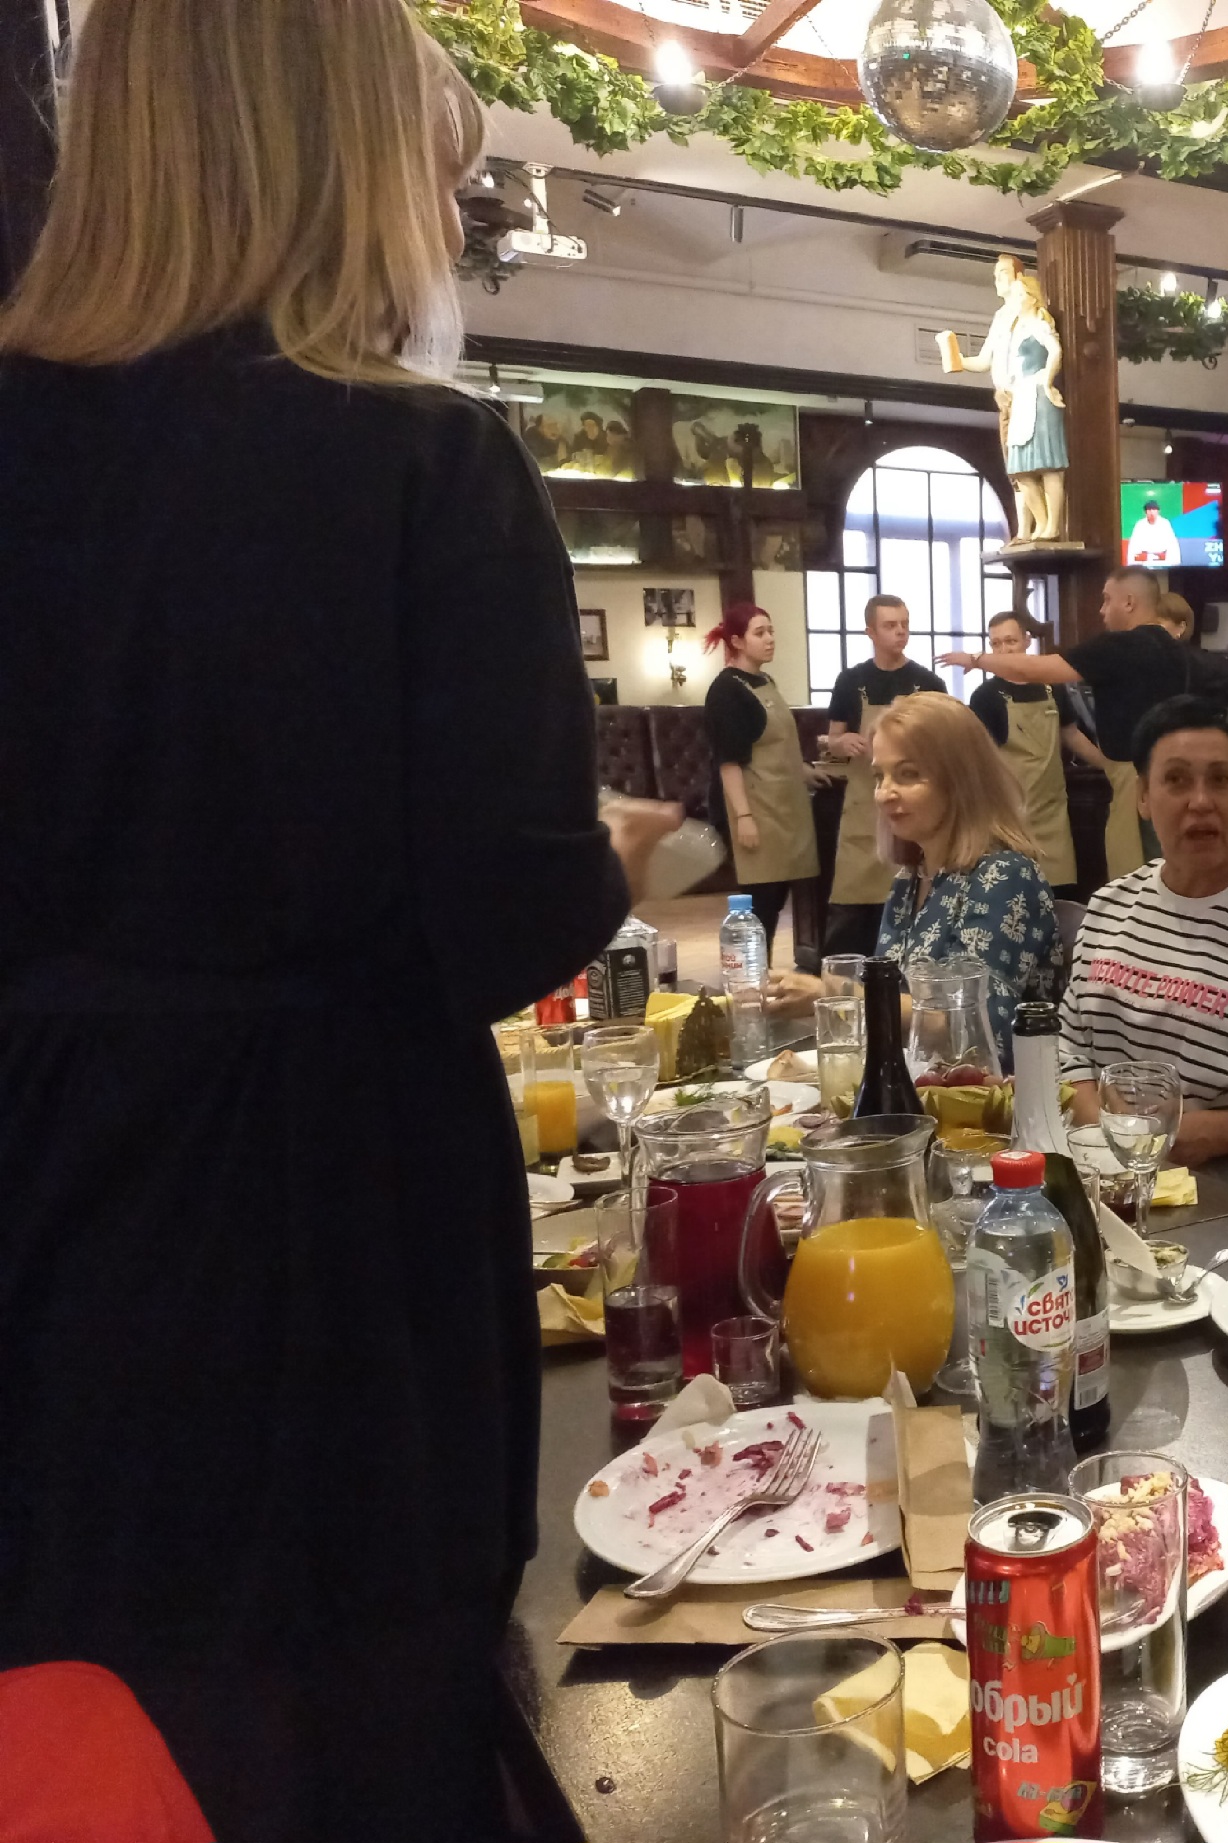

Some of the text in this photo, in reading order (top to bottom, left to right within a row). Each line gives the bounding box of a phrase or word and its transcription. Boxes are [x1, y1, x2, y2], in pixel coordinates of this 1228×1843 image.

[1014, 1310, 1070, 1336] источ
[970, 1672, 1084, 1733] обрый
[983, 1737, 1038, 1763] cola
